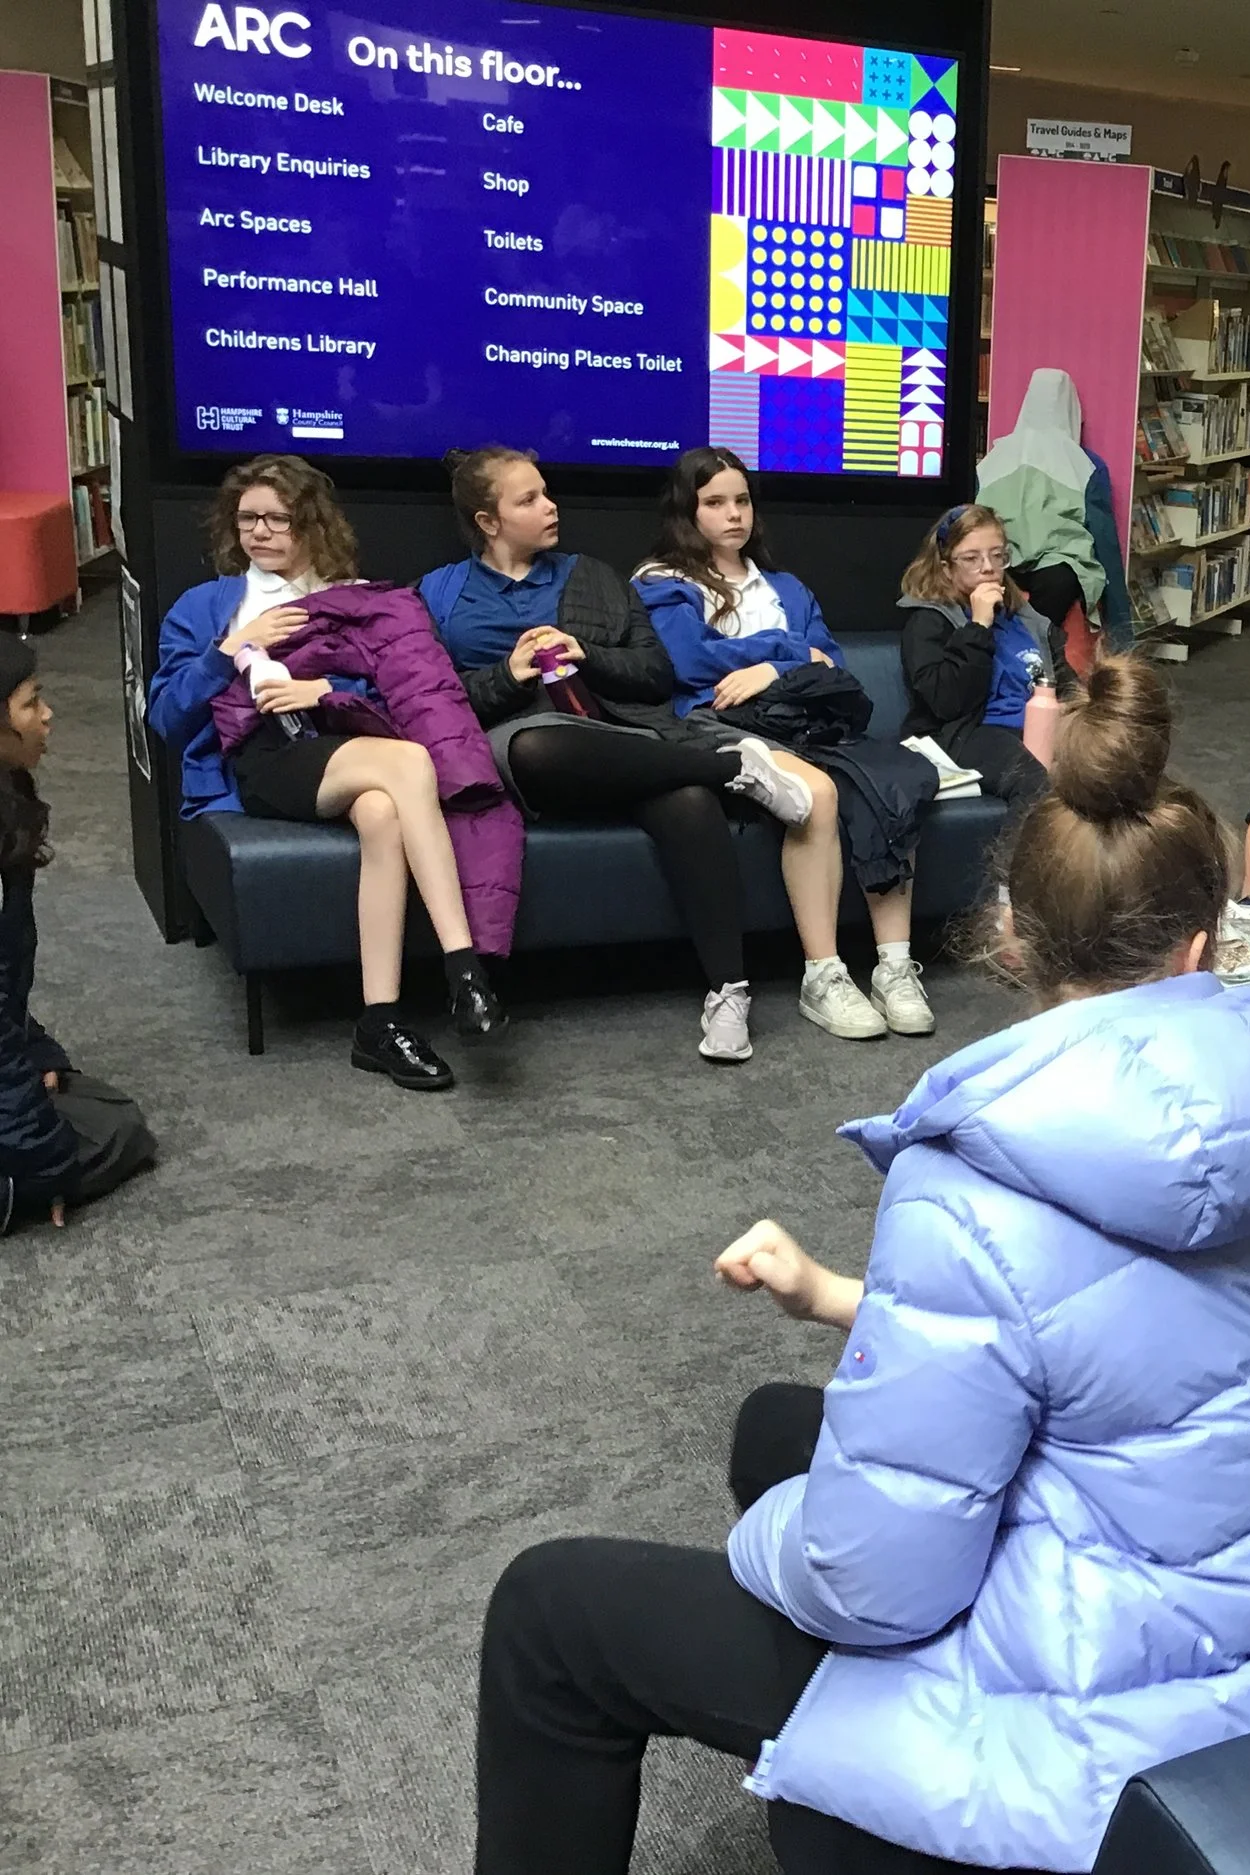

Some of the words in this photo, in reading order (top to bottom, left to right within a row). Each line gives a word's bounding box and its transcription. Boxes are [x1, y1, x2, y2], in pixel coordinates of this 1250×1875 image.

[193, 2, 312, 59] ARC
[347, 36, 399, 70] On
[404, 40, 473, 79] this
[478, 49, 582, 91] floor...
[193, 82, 289, 111] Welcome
[294, 92, 345, 116] Desk
[482, 113, 525, 134] Cafe
[1030, 123, 1059, 136] Travel
[1061, 125, 1092, 138] Guides
[1094, 127, 1101, 139] &
[1103, 128, 1128, 141] Maps
[197, 146, 271, 174] Library
[276, 153, 371, 179] Enquiries
[483, 172, 530, 196] Shop
[199, 207, 235, 228] Arc
[239, 211, 313, 235] Spaces
[484, 229, 544, 252] Toilets
[203, 267, 334, 295] Performance
[338, 277, 379, 298] Hall
[484, 287, 588, 316] Community
[591, 294, 644, 317] Space
[205, 329, 302, 352] Childrens
[307, 333, 377, 360] Library
[485, 343, 570, 370] Changing
[575, 350, 633, 370] Places
[636, 352, 683, 373] Toilet
[220, 408, 262, 417] HAMPSHIRE
[221, 416, 256, 424] CULTURAL
[292, 408, 343, 421] Hampshire
[222, 423, 243, 431] TRUST
[591, 438, 680, 450] arcwinchester.org.uk
